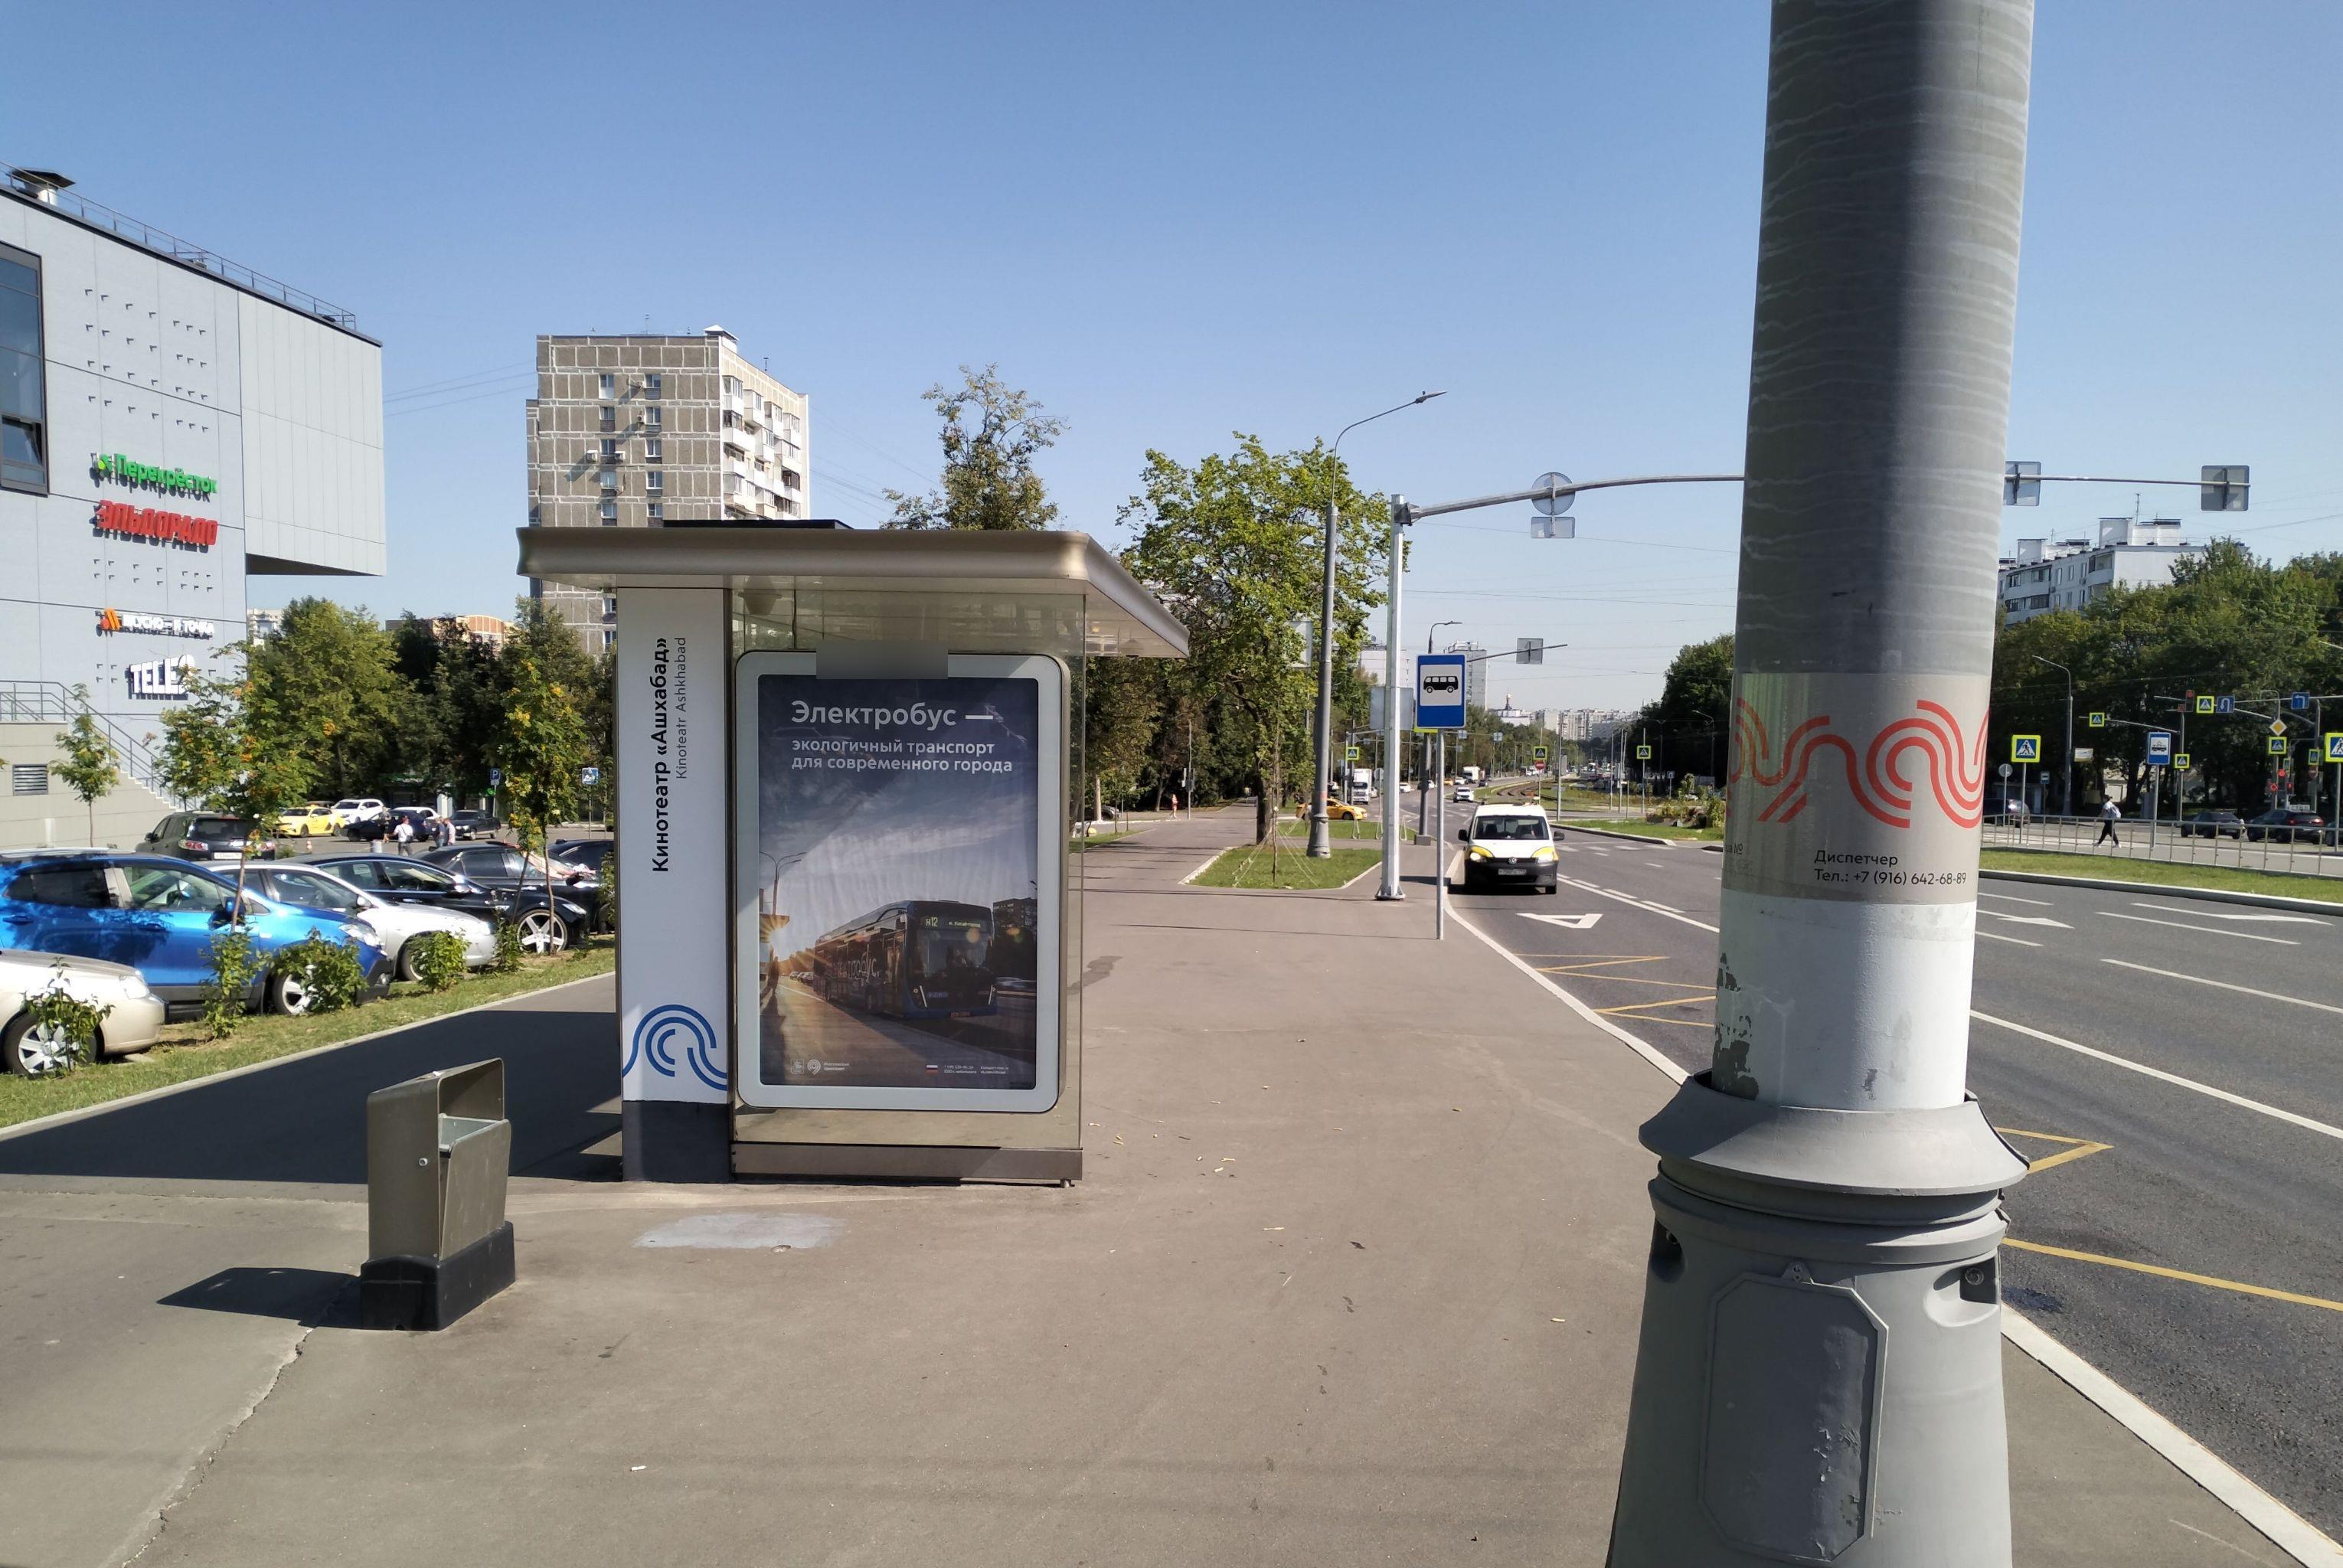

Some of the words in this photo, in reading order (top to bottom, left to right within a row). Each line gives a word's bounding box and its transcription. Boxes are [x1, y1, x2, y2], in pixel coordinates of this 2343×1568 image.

[96, 499, 219, 546] ЭЛЬДОРАДО
[674, 637, 687, 713] Ashkhabad
[649, 637, 670, 756] «Ашхабад»
[791, 700, 956, 731] Электробус
[675, 717, 687, 779] Kinoteatr
[791, 739, 903, 753] экологичный
[907, 741, 995, 757] транспорт
[791, 757, 822, 769] для
[827, 758, 949, 773] современного
[954, 759, 1013, 774] города
[652, 761, 671, 872] Кинотеатр
[1814, 849, 1899, 868] Диспетчер
[1814, 868, 1849, 882] Тел.:
[1854, 871, 1871, 884] +7
[1874, 871, 1907, 886] (916)
[1910, 872, 1967, 885] 642-68-89
